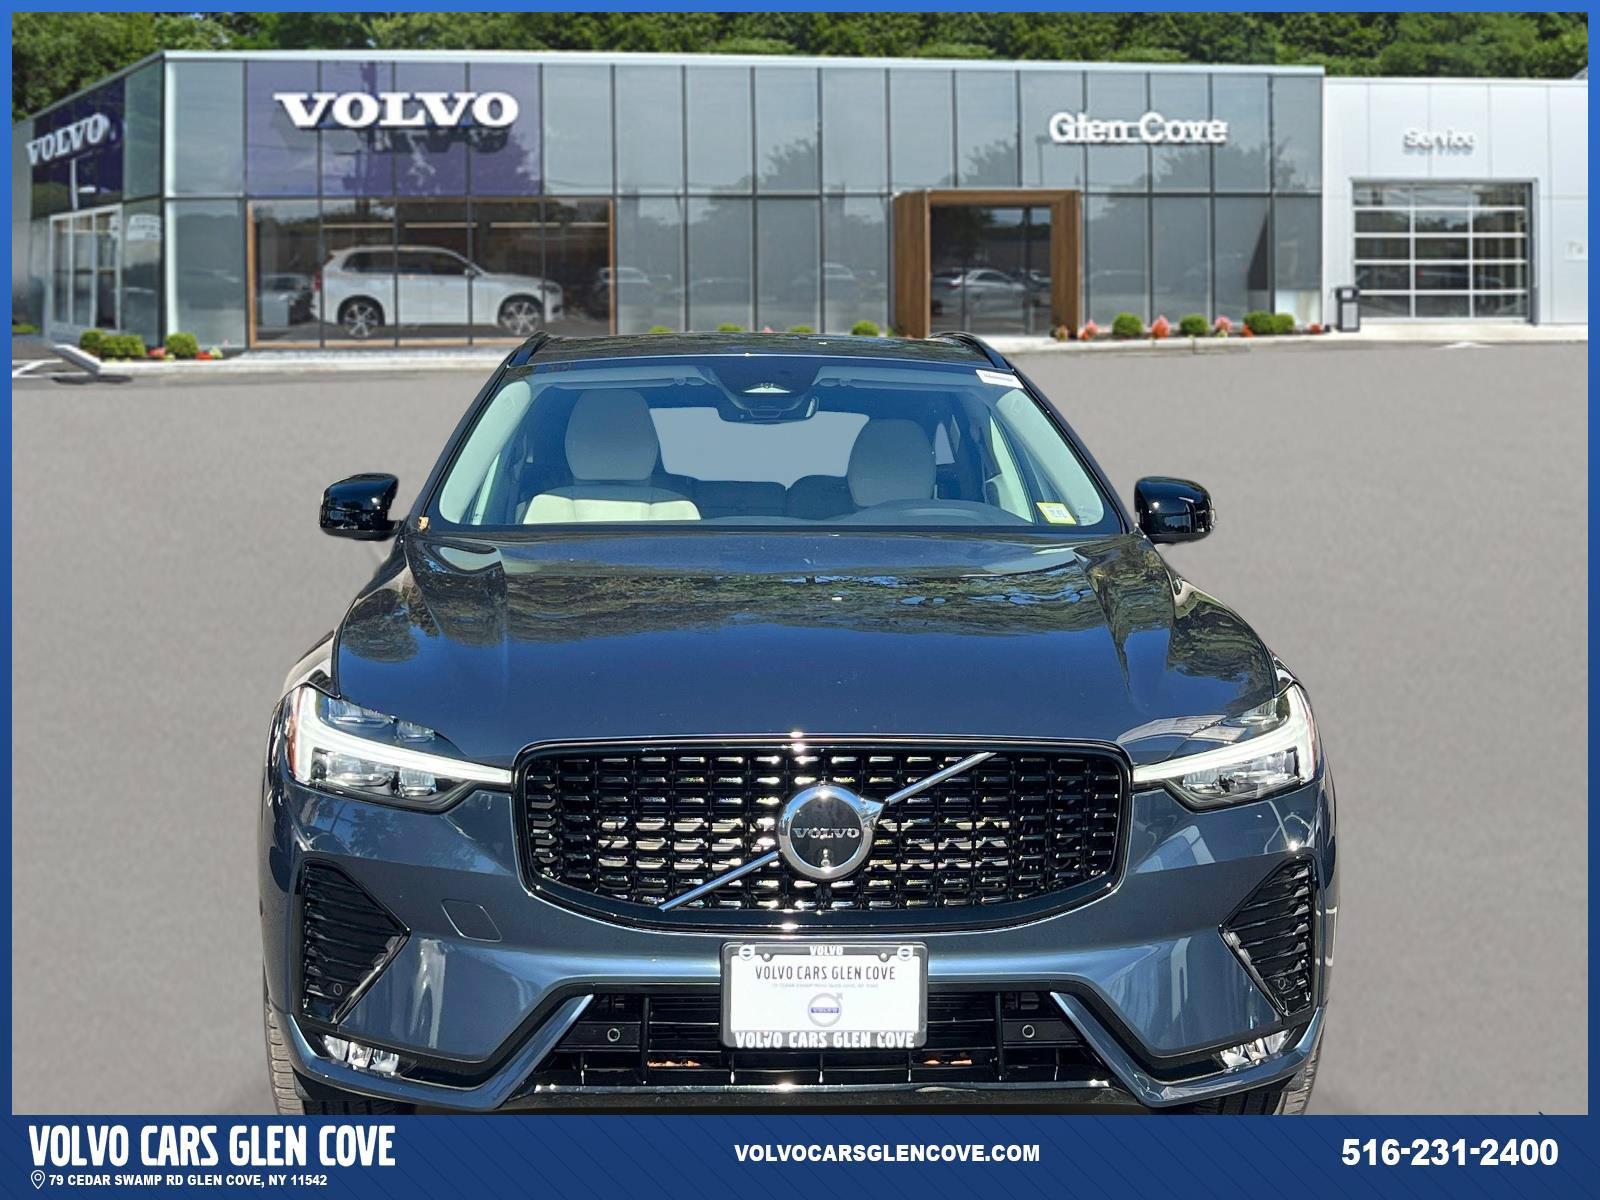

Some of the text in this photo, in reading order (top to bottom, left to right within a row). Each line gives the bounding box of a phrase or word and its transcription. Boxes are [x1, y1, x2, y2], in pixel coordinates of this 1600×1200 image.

[273, 92, 519, 127] VOLVO
[1049, 111, 1228, 143] Glen Cove
[25, 113, 110, 166] VOLVO
[1402, 127, 1477, 155] Service
[791, 827, 860, 840] VOLVO
[809, 944, 844, 956] VOLVO
[755, 965, 896, 980] VOLVO CARS GLEN COVE
[735, 1031, 915, 1049] VOLVO CARS GLEN COVE
